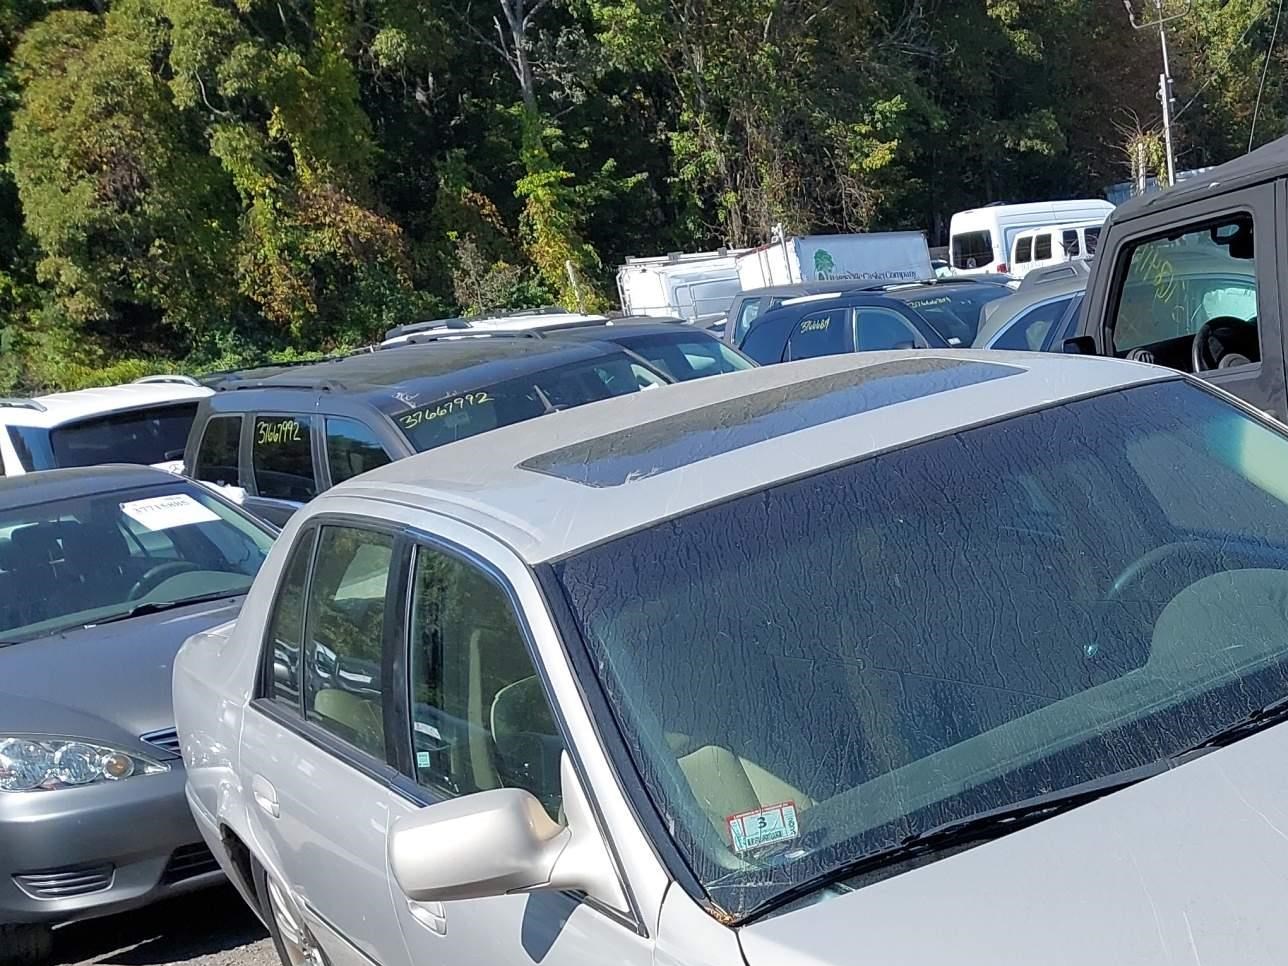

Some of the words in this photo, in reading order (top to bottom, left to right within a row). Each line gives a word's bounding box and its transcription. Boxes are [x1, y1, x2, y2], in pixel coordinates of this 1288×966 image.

[885, 270, 917, 280] Company
[400, 392, 494, 429] 37667992
[257, 420, 301, 445] 37667992
[756, 816, 768, 829] 3
